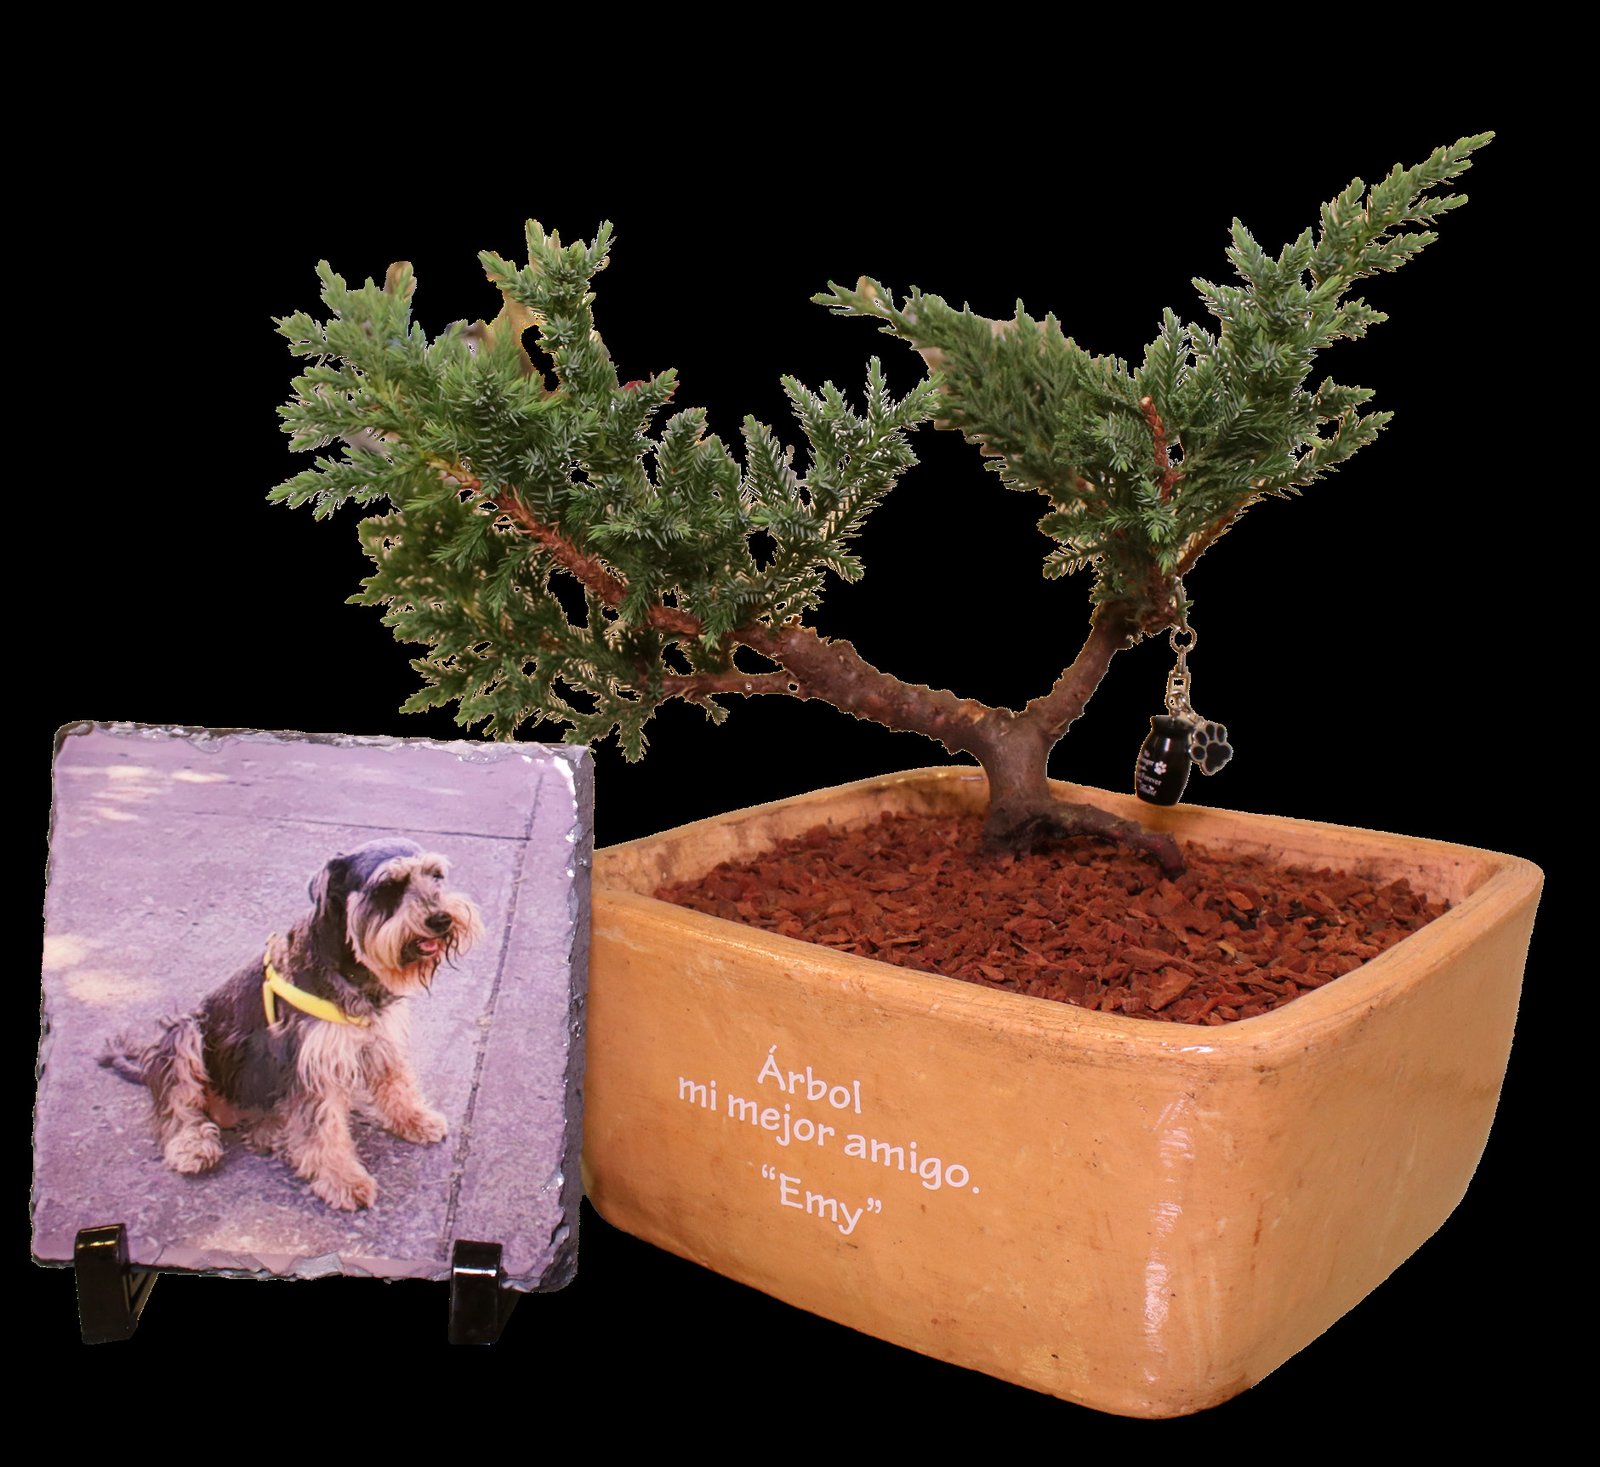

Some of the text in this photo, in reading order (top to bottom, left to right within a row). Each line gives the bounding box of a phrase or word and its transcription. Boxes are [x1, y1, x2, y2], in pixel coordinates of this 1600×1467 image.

[757, 1044, 862, 1114] Árbol
[678, 1076, 980, 1194] mi mejor amigo.
